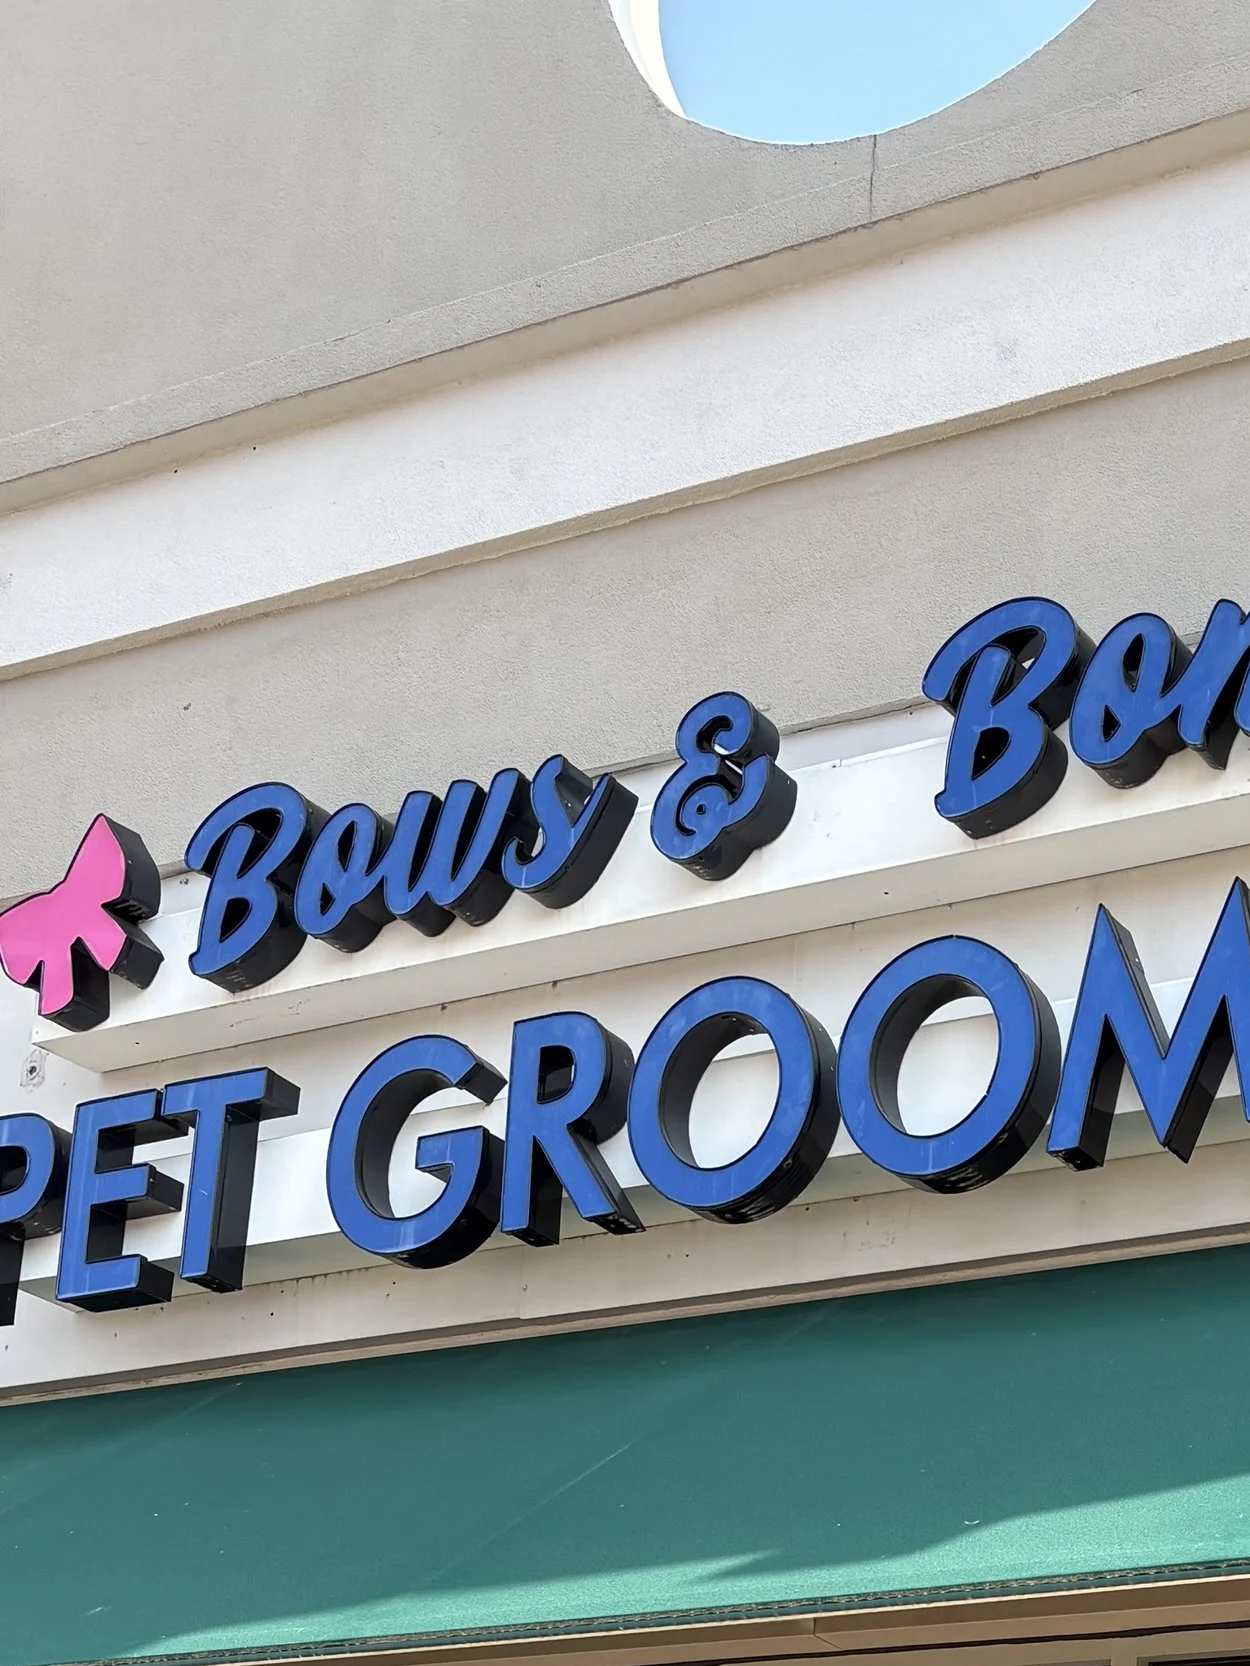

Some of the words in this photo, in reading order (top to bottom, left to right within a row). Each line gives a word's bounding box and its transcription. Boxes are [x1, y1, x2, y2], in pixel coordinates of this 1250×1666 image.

[186, 754, 622, 984] Bows
[650, 690, 778, 868] &
[0, 1067, 285, 1308] PET
